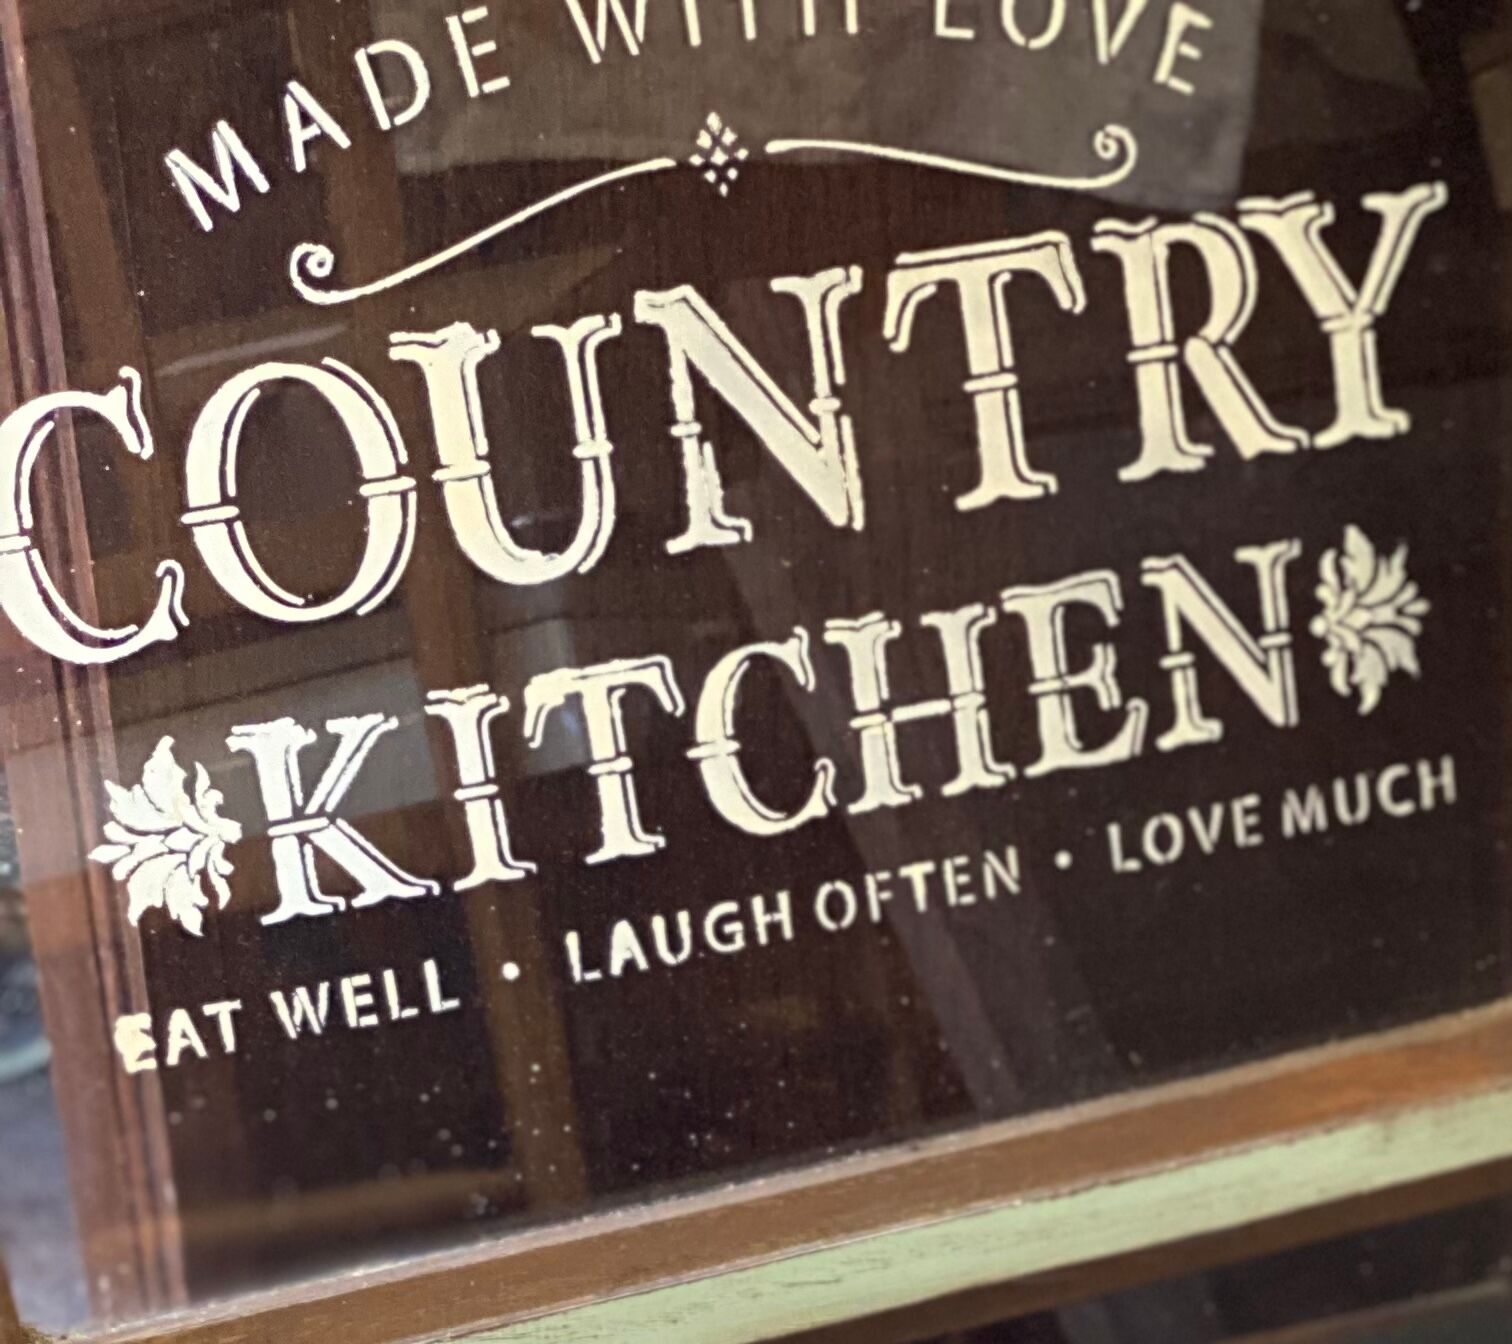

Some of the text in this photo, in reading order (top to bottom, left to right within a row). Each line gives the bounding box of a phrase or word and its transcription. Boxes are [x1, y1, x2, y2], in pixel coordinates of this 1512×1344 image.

[164, 6, 511, 232] MADE
[935, 0, 1213, 95] LOVE
[0, 181, 1450, 666] COUNTRY
[228, 538, 1303, 929] KITCHEN
[113, 754, 1457, 1074] EAT WELL LAUGH OFTEN LOVE MUCH
